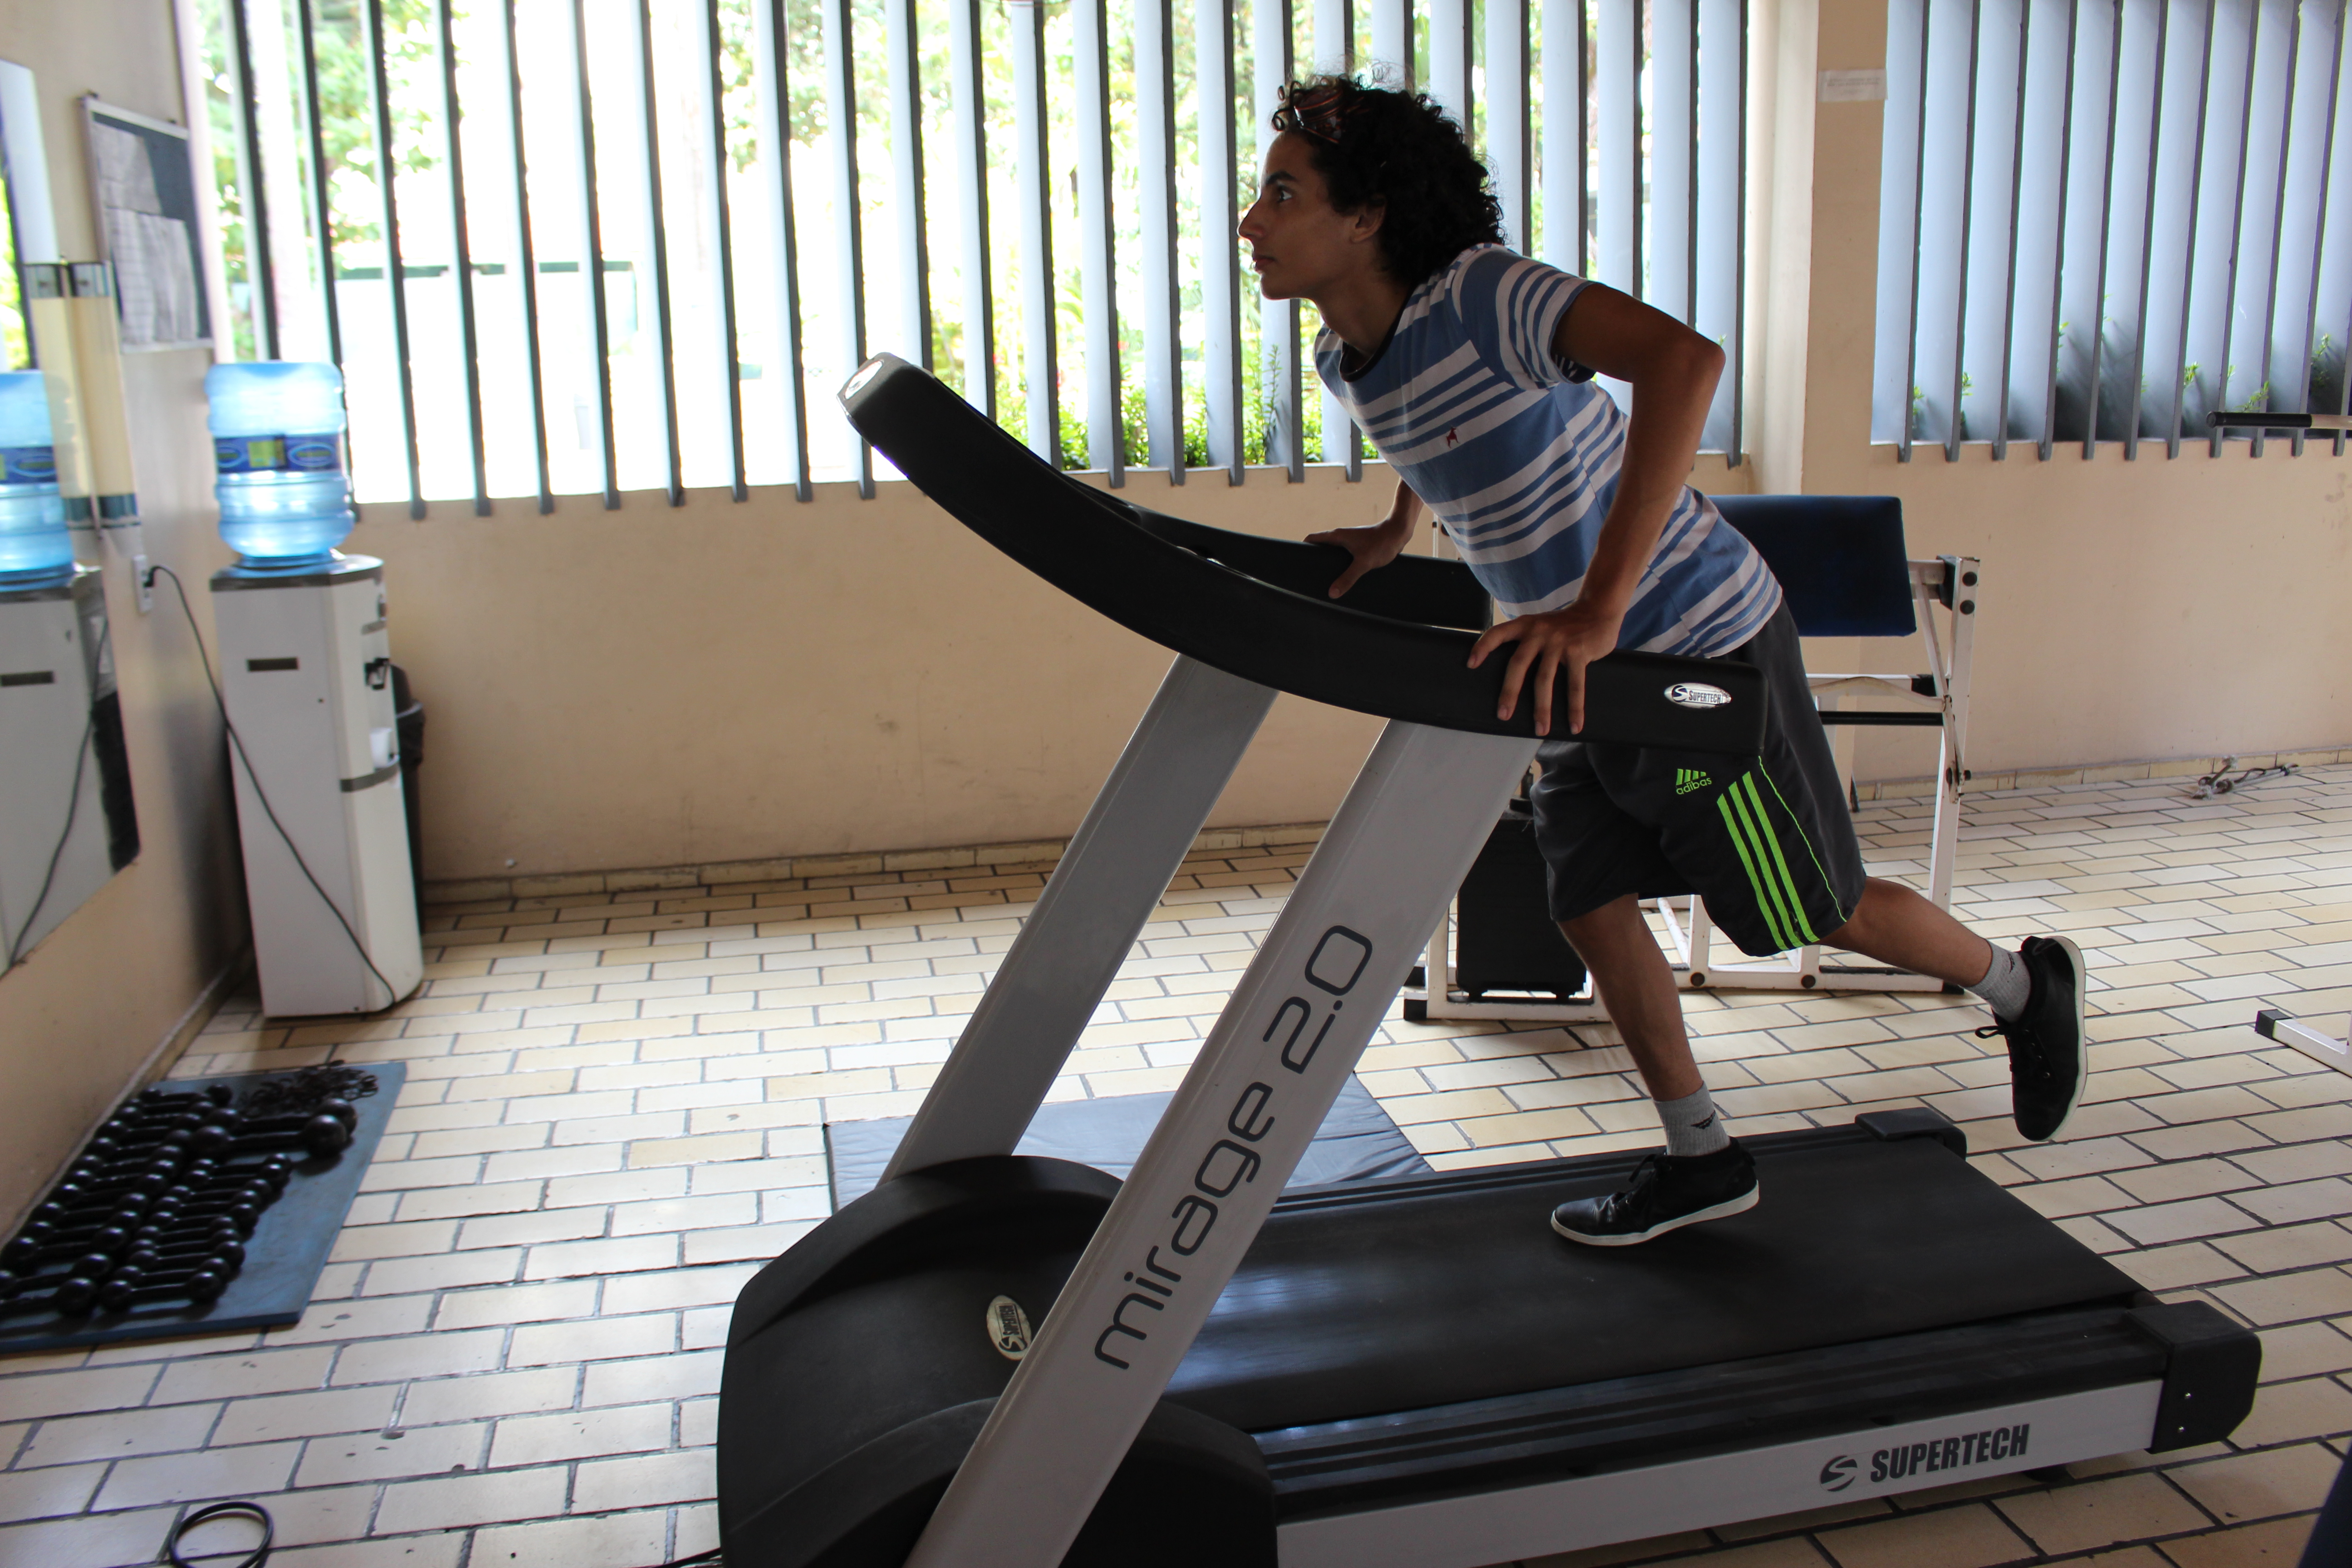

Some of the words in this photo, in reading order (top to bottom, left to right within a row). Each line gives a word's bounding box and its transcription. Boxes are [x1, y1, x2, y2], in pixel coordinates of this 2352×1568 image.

[1688, 690, 1721, 704] SUPERTECH
[1676, 777, 1712, 795] adibas
[1094, 1081, 1275, 1370] mirage
[1262, 925, 1373, 1074] 2.0
[999, 1304, 1019, 1335] SUPERTECH
[1870, 1424, 2029, 1483] SUPERTECH
